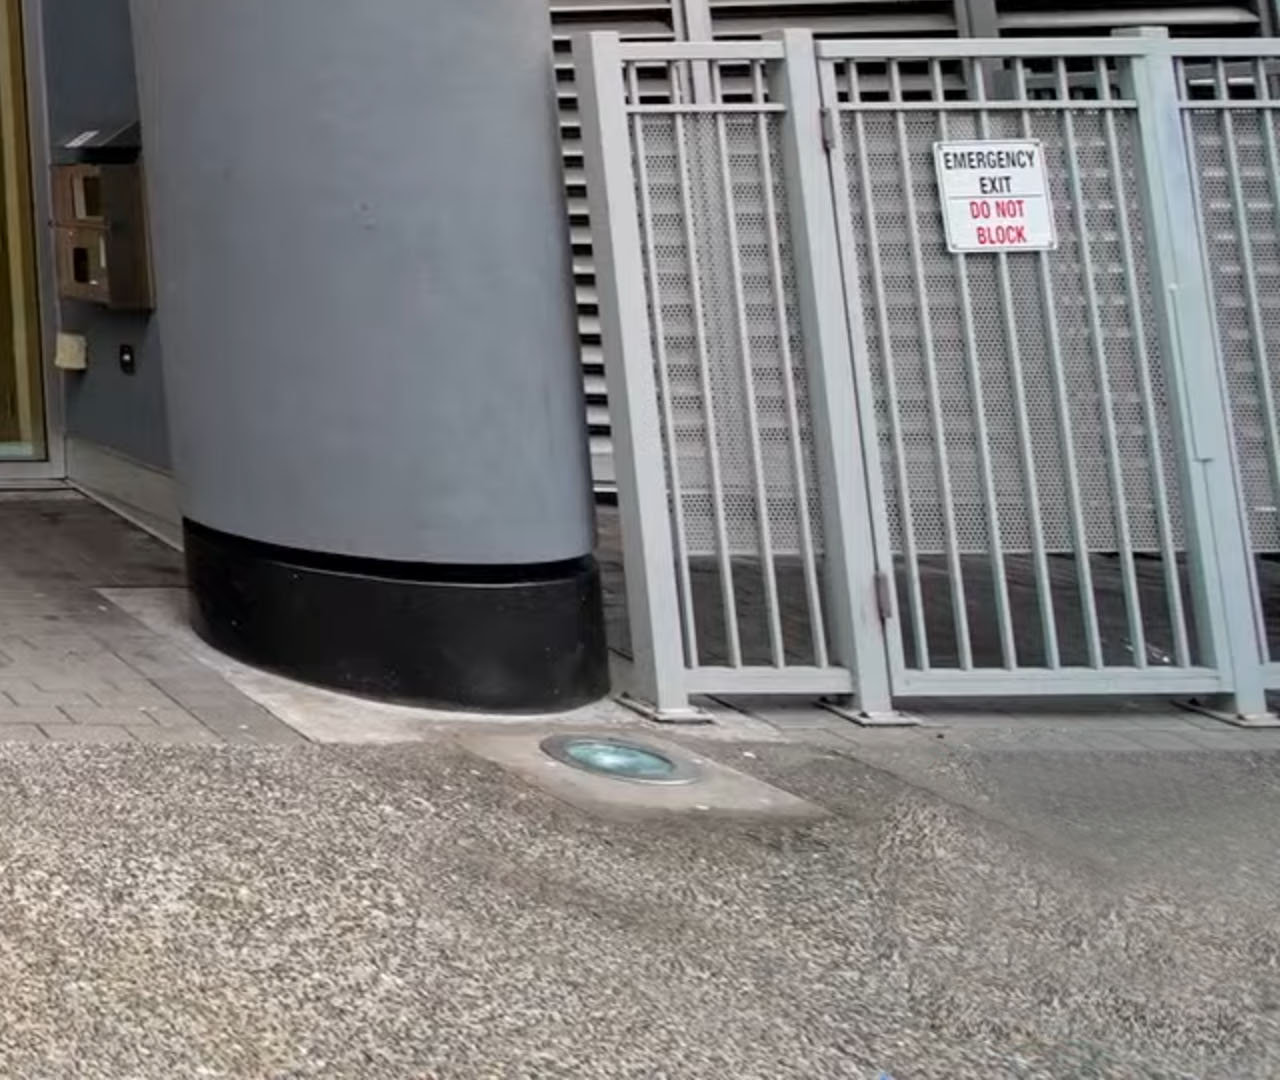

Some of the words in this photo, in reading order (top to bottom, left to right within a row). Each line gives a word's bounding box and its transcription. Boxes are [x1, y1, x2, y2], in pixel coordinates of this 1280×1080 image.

[943, 150, 1035, 170] EMERGENCY
[979, 176, 1012, 195] EXIT
[969, 200, 991, 219] DO
[995, 199, 1025, 218] NOT
[976, 225, 1027, 245] BLOCK
